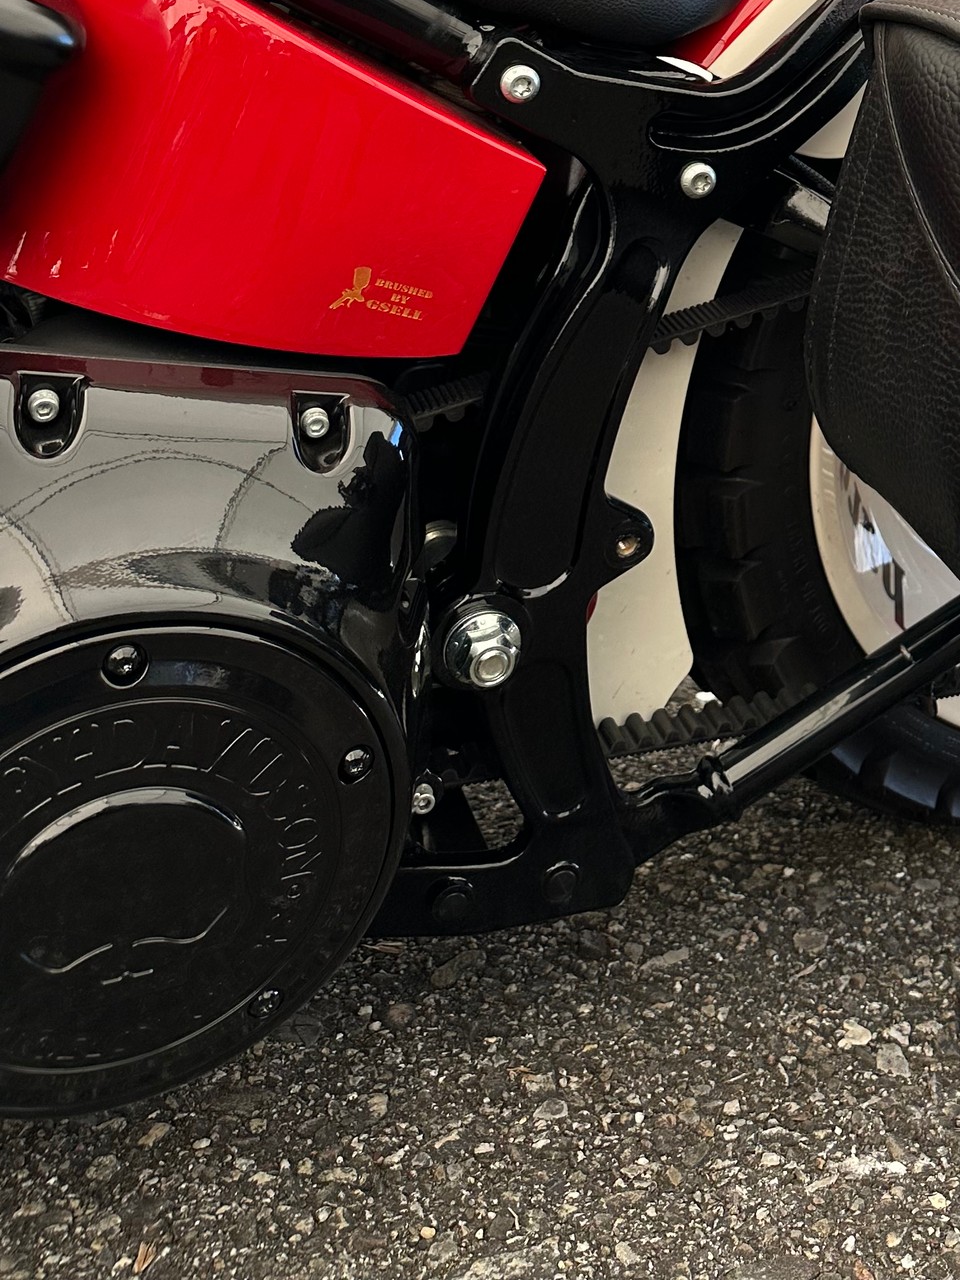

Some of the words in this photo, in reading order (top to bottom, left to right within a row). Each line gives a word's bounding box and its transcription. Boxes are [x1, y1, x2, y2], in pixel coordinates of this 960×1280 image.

[374, 278, 434, 299] BRUSHED
[390, 292, 411, 305] BY
[366, 299, 423, 321] GSELL
